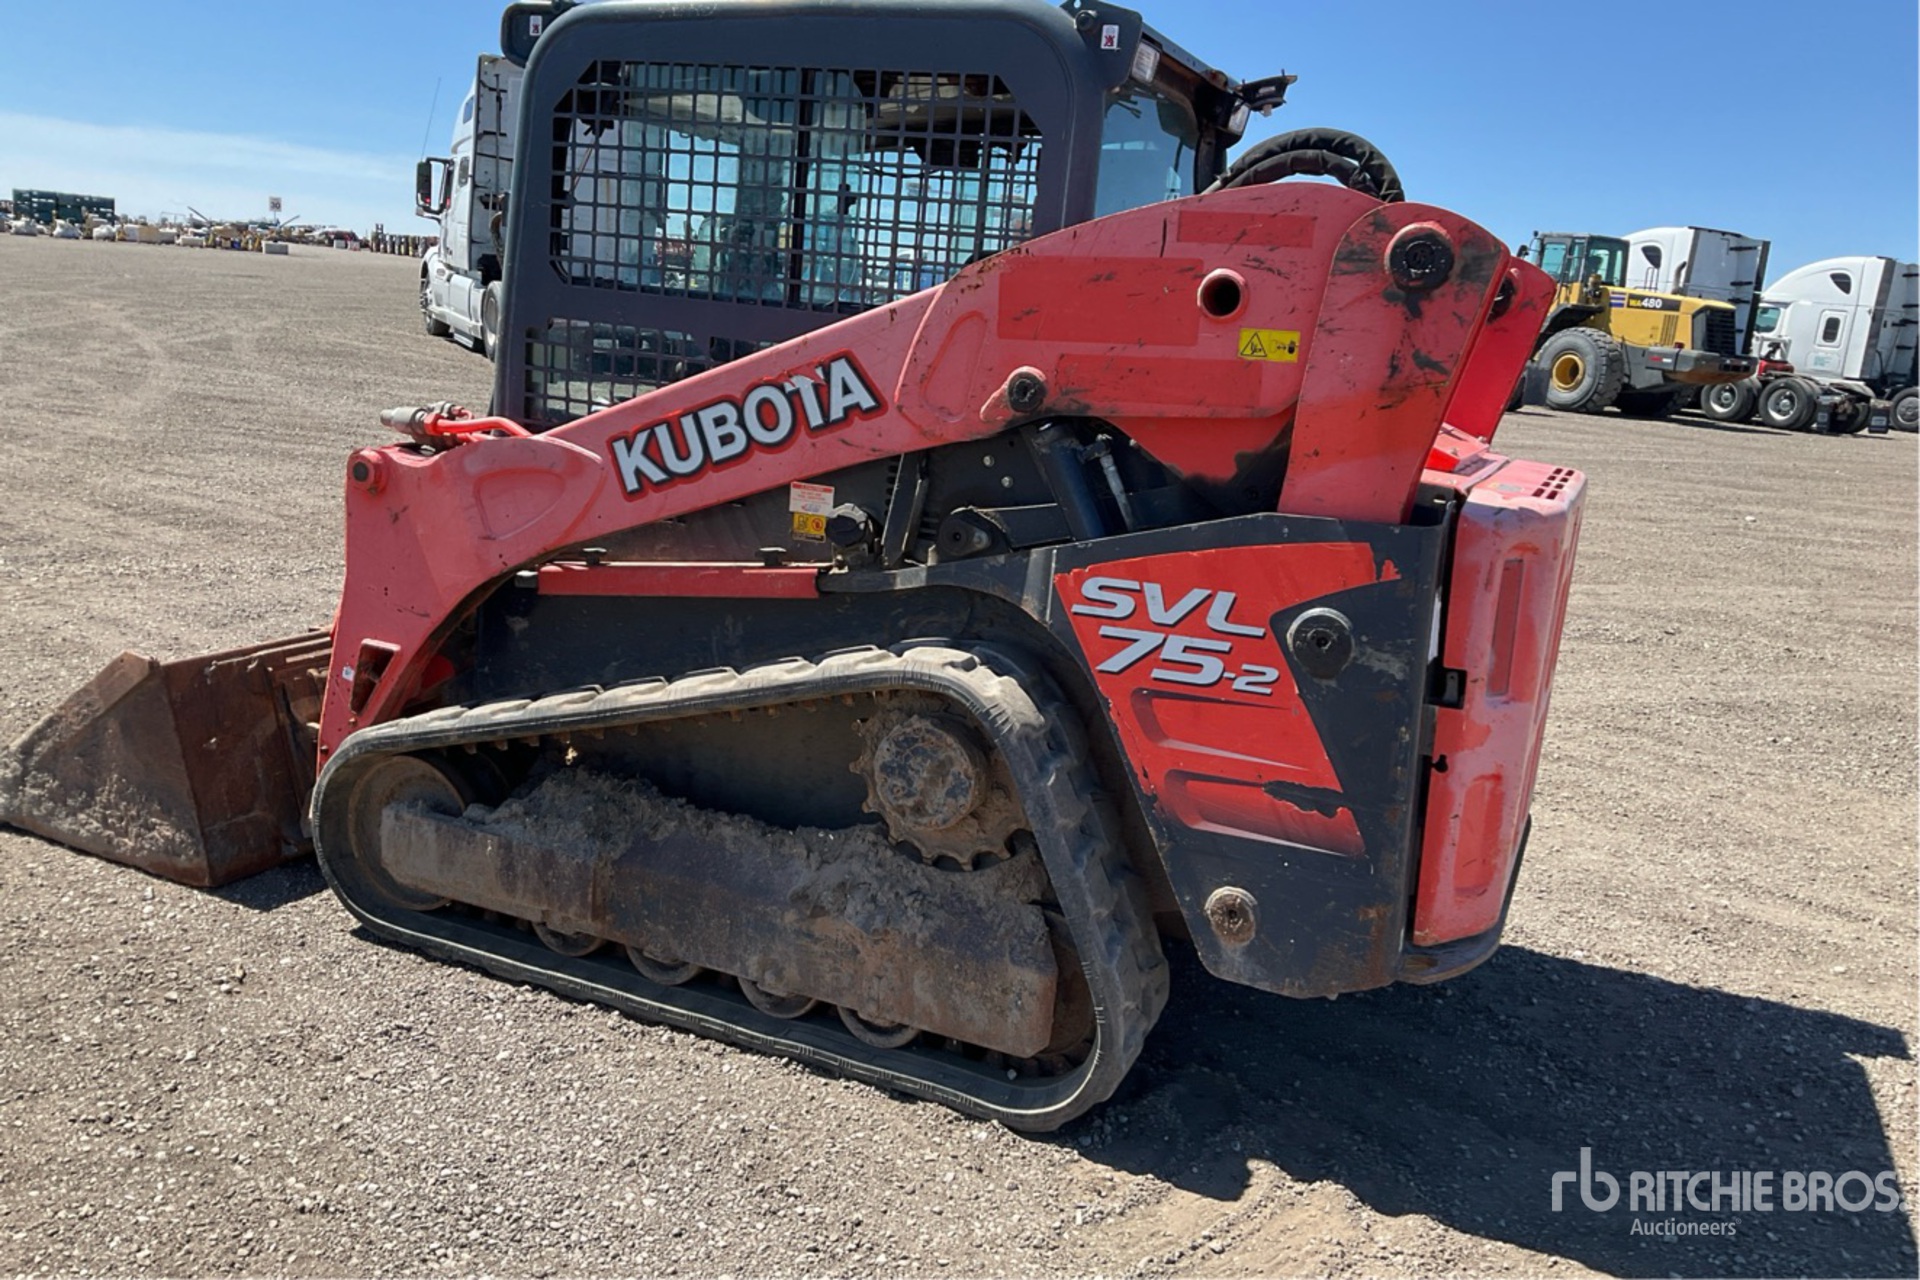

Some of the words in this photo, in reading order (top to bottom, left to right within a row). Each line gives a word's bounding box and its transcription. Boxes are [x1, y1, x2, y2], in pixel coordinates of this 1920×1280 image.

[611, 357, 879, 493] KUBOTA
[1071, 576, 1265, 636] SVL
[1096, 625, 1279, 694] 75-2
